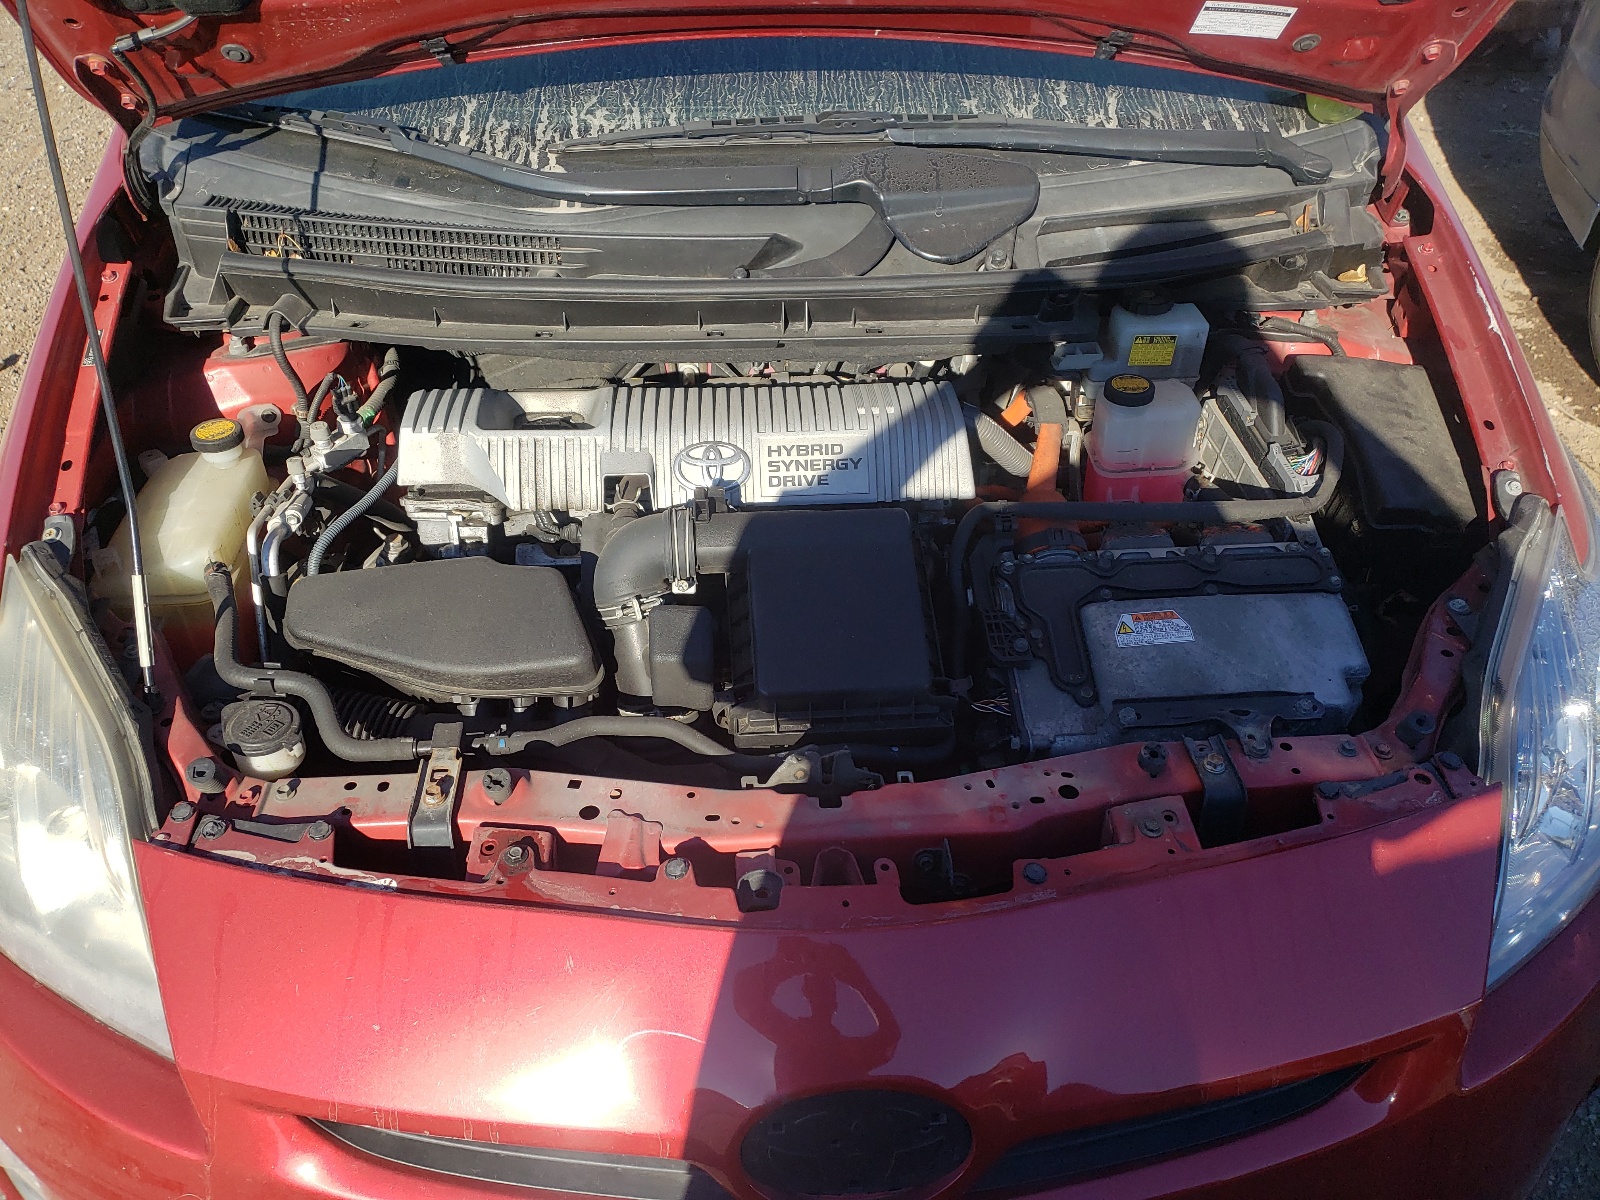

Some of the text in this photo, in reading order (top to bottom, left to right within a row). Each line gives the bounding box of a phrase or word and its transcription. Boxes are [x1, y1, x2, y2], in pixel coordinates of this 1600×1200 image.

[767, 443, 844, 457] HYBRID
[767, 457, 863, 472] SYNERGY
[768, 474, 829, 487] DRIVE
